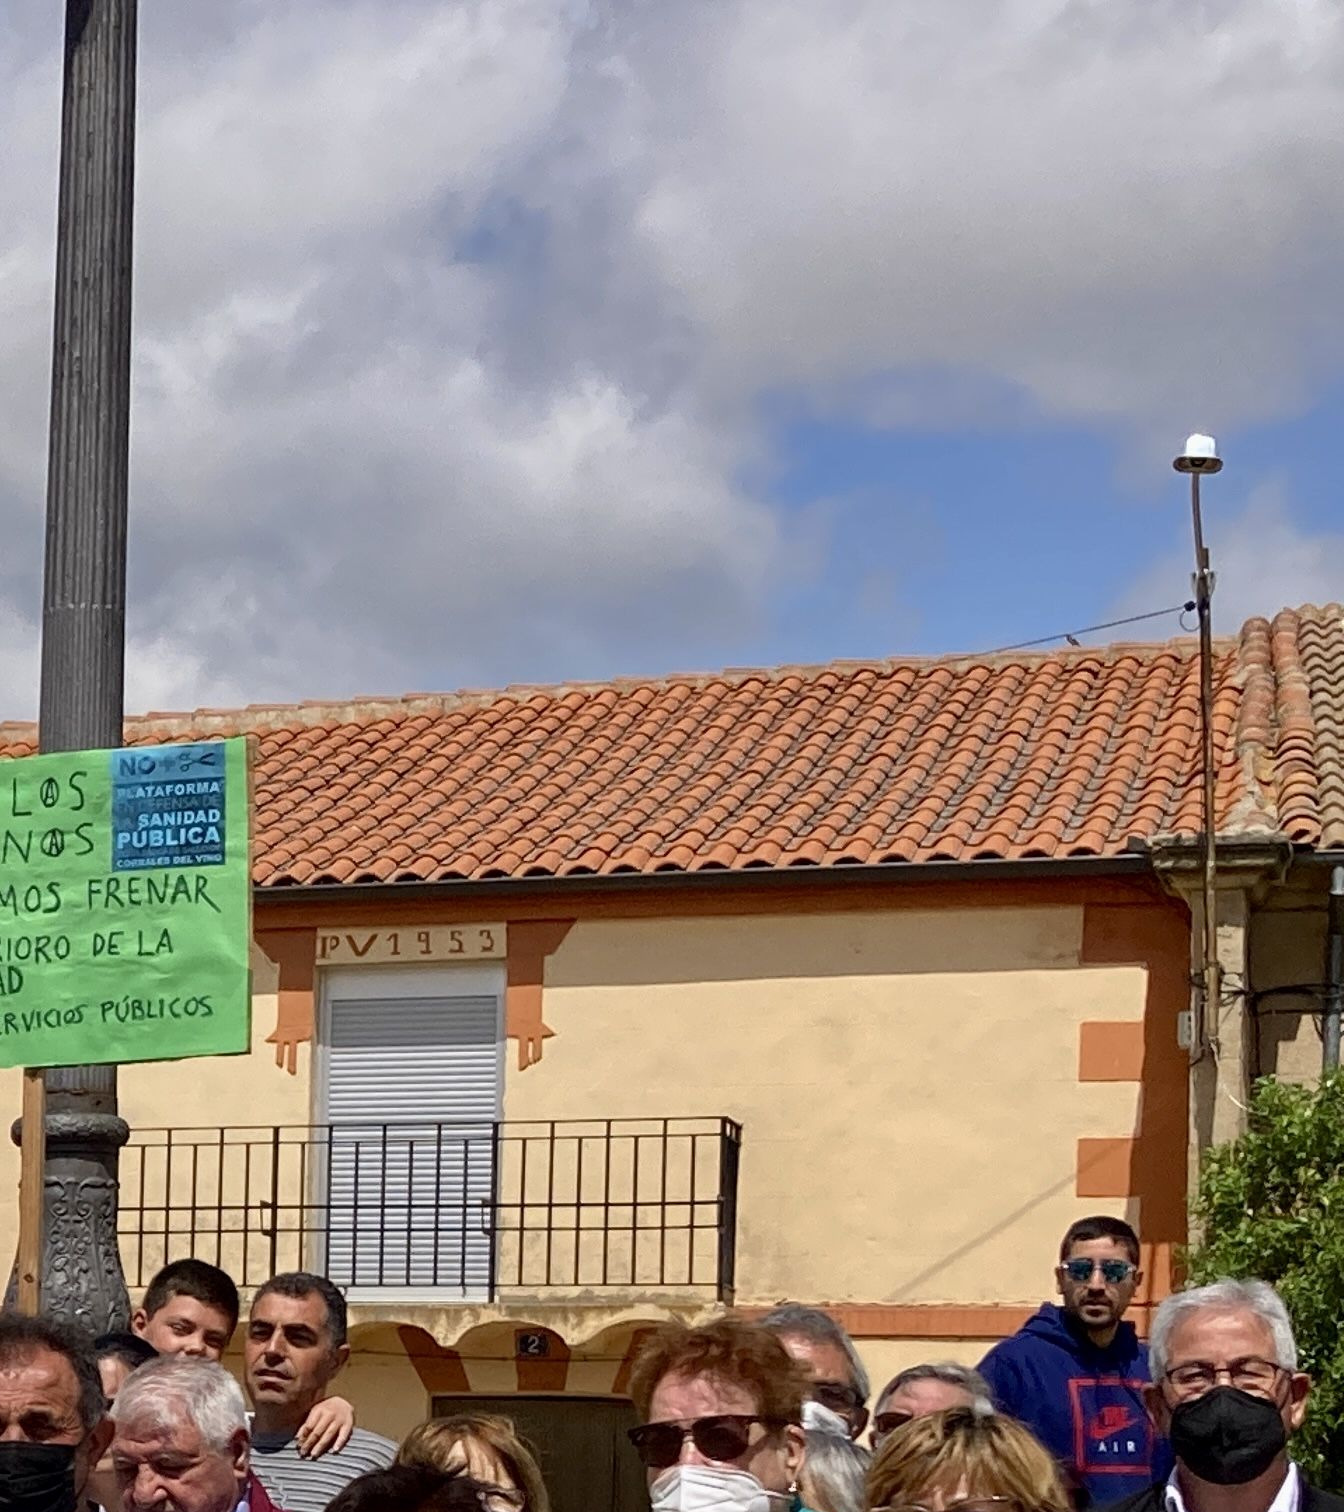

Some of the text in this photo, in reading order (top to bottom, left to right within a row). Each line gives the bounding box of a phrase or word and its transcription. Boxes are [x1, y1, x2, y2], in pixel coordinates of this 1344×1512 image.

[116, 781, 221, 799] PLATAFORMA
[137, 808, 221, 828] SANIDAD
[116, 825, 221, 850] PÚBLICA
[172, 854, 193, 864] DEL
[87, 874, 221, 913] FRENAR
[92, 930, 121, 957] DE
[137, 928, 174, 958] LA
[101, 995, 213, 1025] PÚBLICOS
[527, 1335, 540, 1353] 2
[1098, 1440, 1136, 1453] AIR
